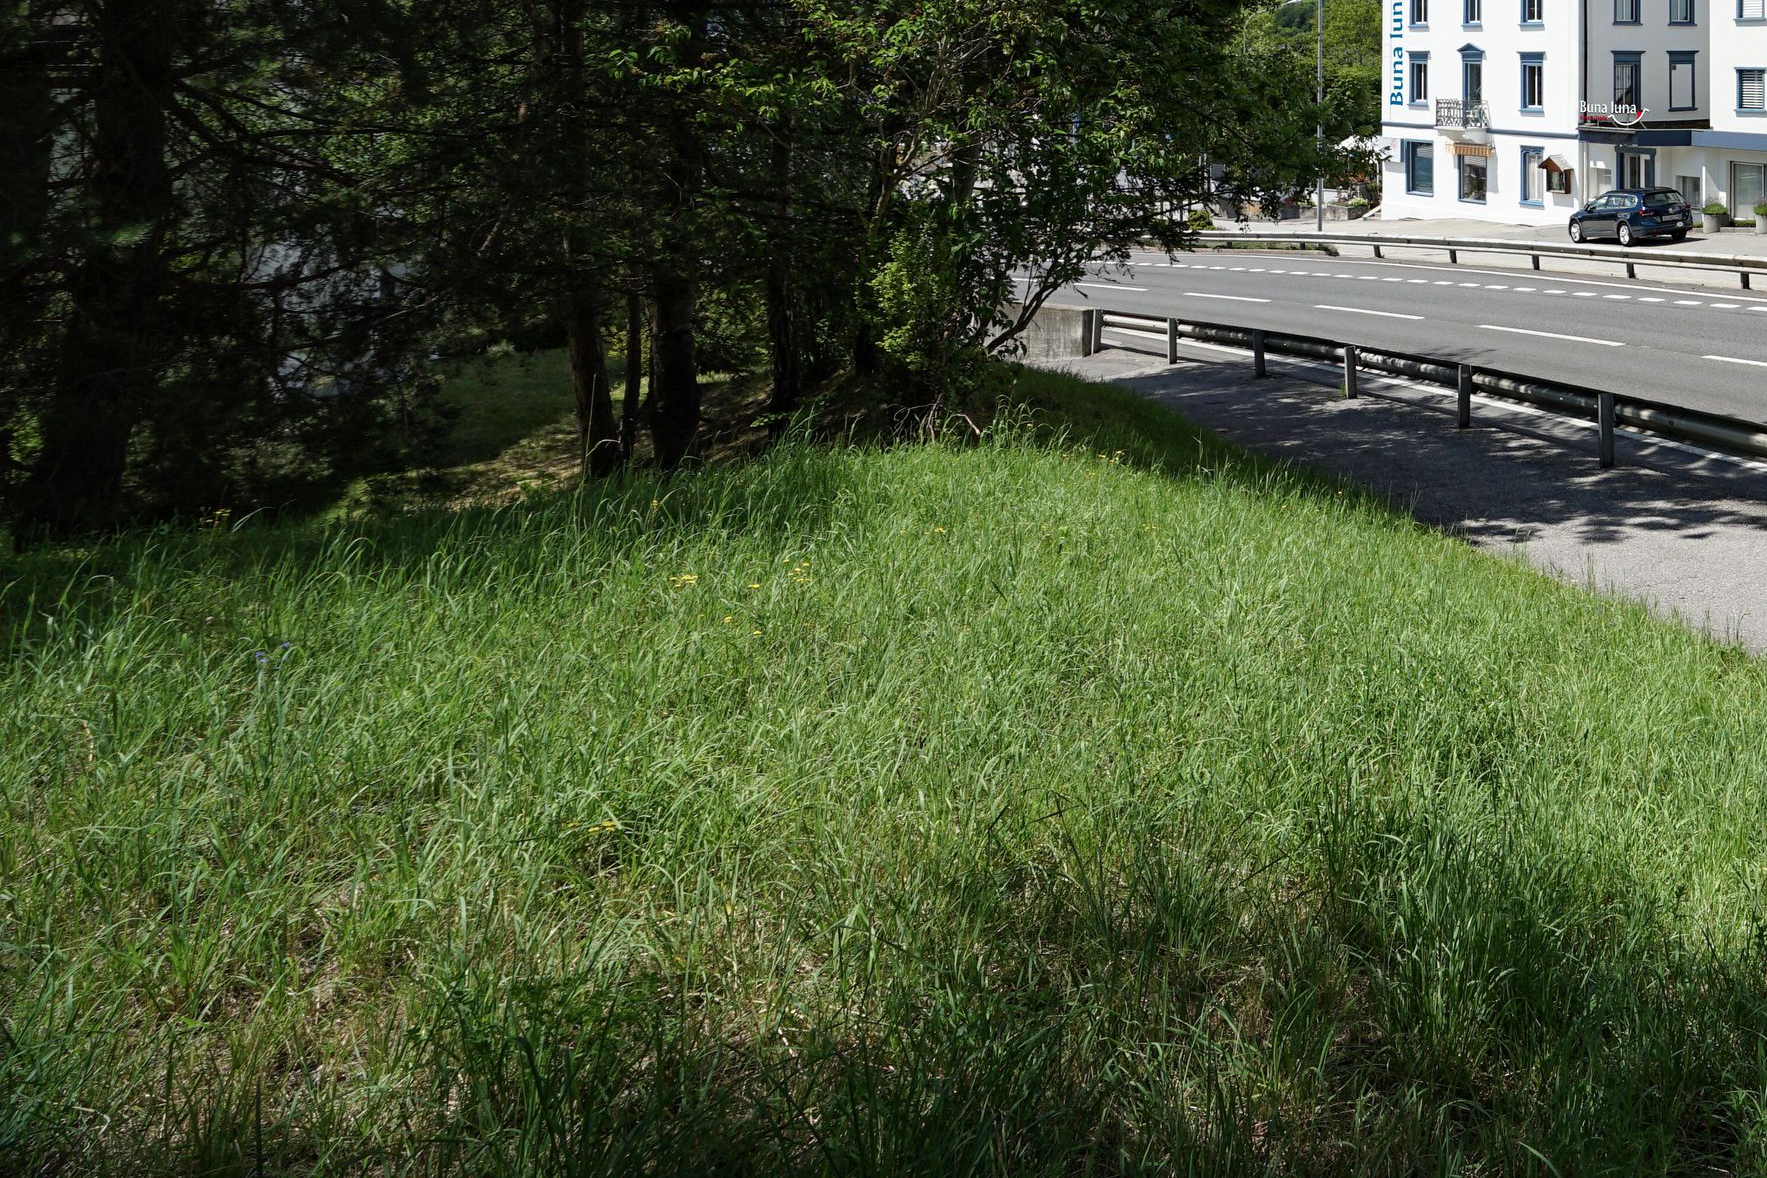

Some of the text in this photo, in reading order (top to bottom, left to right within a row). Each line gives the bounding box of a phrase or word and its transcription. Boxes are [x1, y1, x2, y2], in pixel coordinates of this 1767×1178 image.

[1390, 47, 1404, 106] Buna
[1580, 100, 1637, 114] Buna luna
